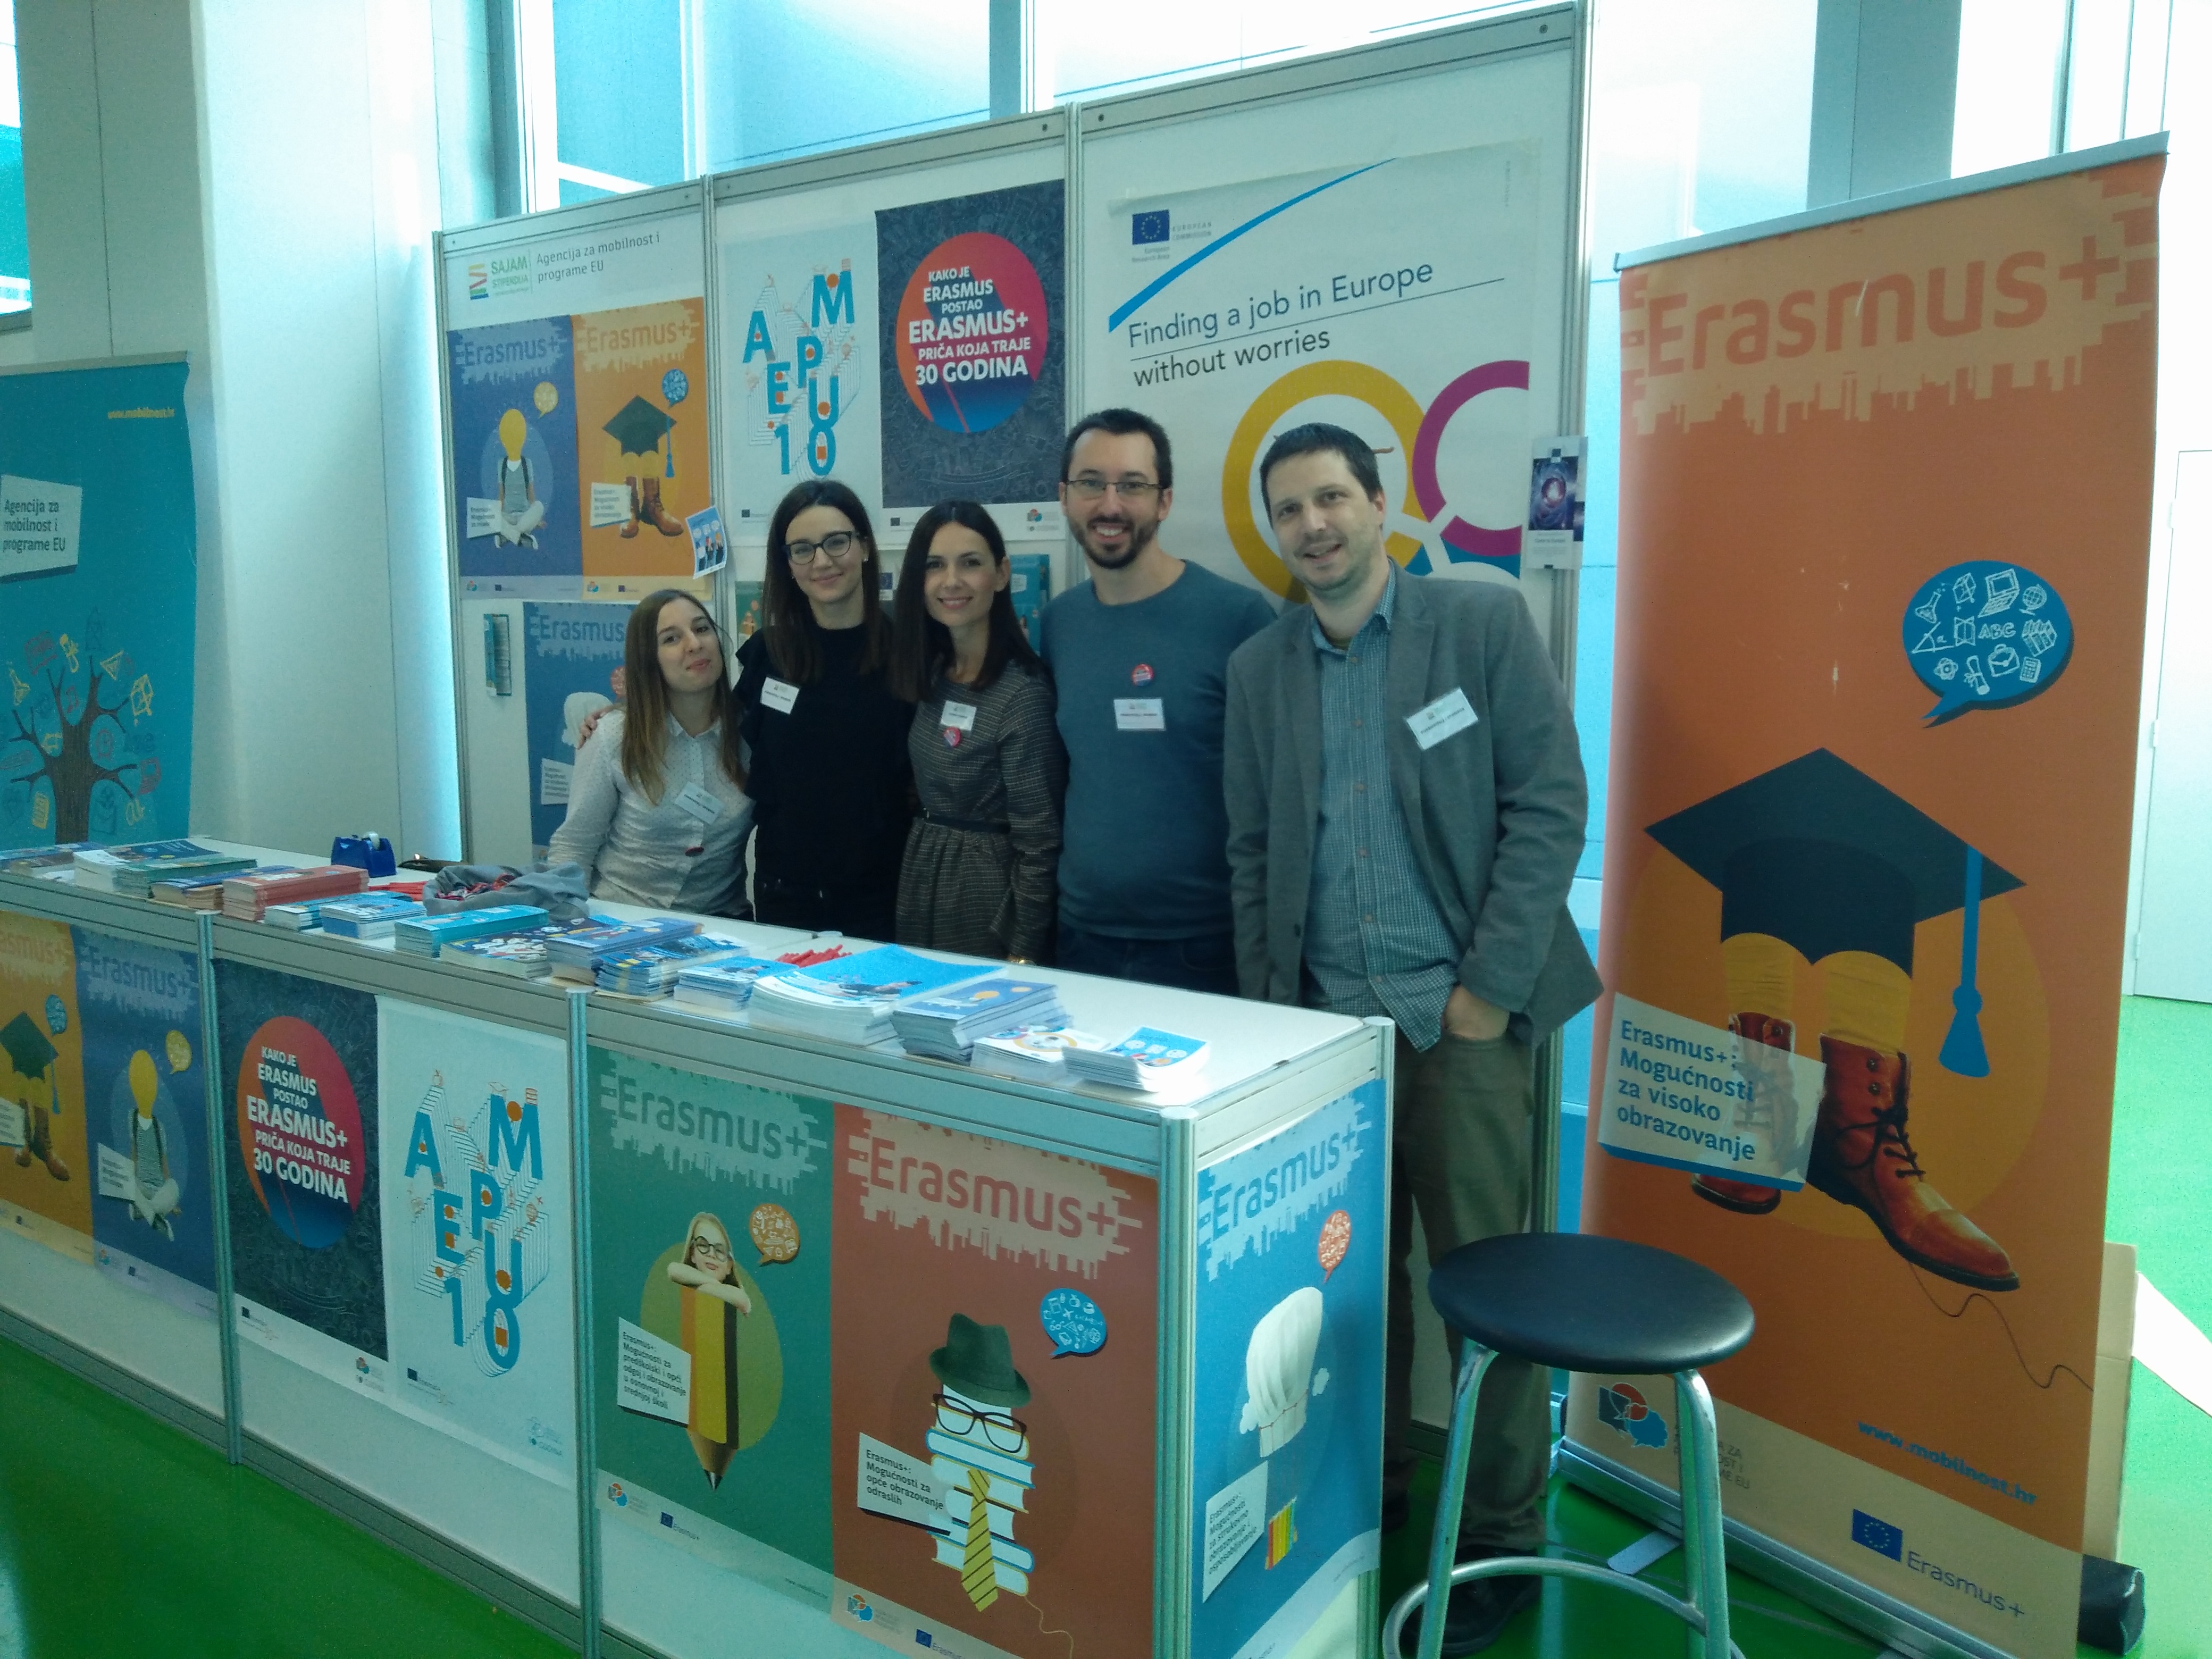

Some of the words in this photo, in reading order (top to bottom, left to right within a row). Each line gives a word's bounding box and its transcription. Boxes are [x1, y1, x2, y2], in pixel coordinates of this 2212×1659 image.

[1172, 222, 1212, 232] EUROPEAN
[537, 247, 581, 266] Agencija
[584, 246, 595, 256] za
[598, 235, 653, 253] mobilnost
[656, 231, 660, 243] i
[491, 256, 527, 275] SAJAM
[538, 265, 587, 283] programe
[591, 260, 604, 273] EU
[928, 269, 957, 282] KAKO
[959, 266, 970, 278] JE
[924, 279, 993, 303] ERASMUS
[942, 299, 983, 314] POSTAO
[1128, 313, 1218, 347] Finding
[1227, 307, 1241, 326] a
[1248, 290, 1289, 329] job
[1300, 285, 1321, 310] in
[1333, 263, 1434, 302] Europe
[1648, 236, 2119, 377] Erasmus+
[587, 320, 691, 353] Erasmus+
[909, 309, 1028, 343] ERASMUS+
[464, 337, 559, 366] Erasmus+
[919, 342, 954, 361] PRIČA
[957, 343, 989, 357] KOJA
[992, 337, 1030, 353] TRAJE
[1134, 349, 1226, 387] without
[1235, 329, 1330, 366] worries
[916, 364, 938, 386] 30
[943, 355, 1028, 382] GODINA
[4, 499, 45, 516] Agencija
[48, 502, 60, 512] za
[4, 517, 52, 531] mobilnost
[55, 518, 57, 531] i
[3, 539, 51, 554] programe
[53, 537, 66, 551] EU
[1978, 622, 2016, 639] ABC
[89, 945, 188, 998] Erasmus+
[261, 1046, 286, 1064] KAKO
[287, 1053, 297, 1067] JE
[1621, 1020, 1737, 1069] Erasmus+:
[257, 1063, 317, 1096] ERASMUS
[1620, 1047, 1754, 1102] Mogućnosti
[273, 1087, 308, 1110] POSTAO
[1619, 1079, 1640, 1099] za
[1648, 1086, 1721, 1121] visoko
[247, 1095, 348, 1149] ERASMUS+
[618, 1075, 807, 1159] Erasmus+
[1617, 1105, 1756, 1161] obrazovanje
[256, 1129, 284, 1152] PRIČA
[287, 1141, 315, 1163] KOJA
[316, 1151, 350, 1175] TRAJE
[254, 1147, 273, 1174] 30
[276, 1157, 349, 1203] GODINA
[870, 1136, 1116, 1239] Erasmus+
[1213, 1122, 1356, 1241] Erasmus+
[866, 1449, 911, 1473] Erasmus+:
[867, 1462, 918, 1488] Mogućnosti
[920, 1482, 931, 1493] za
[1858, 1421, 2037, 1505] www.mobilnost.hr
[867, 1474, 887, 1488] opće
[890, 1482, 943, 1510] obrazovanje
[867, 1486, 902, 1505] odraslih
[1907, 1550, 2025, 1617] Erasmus+
